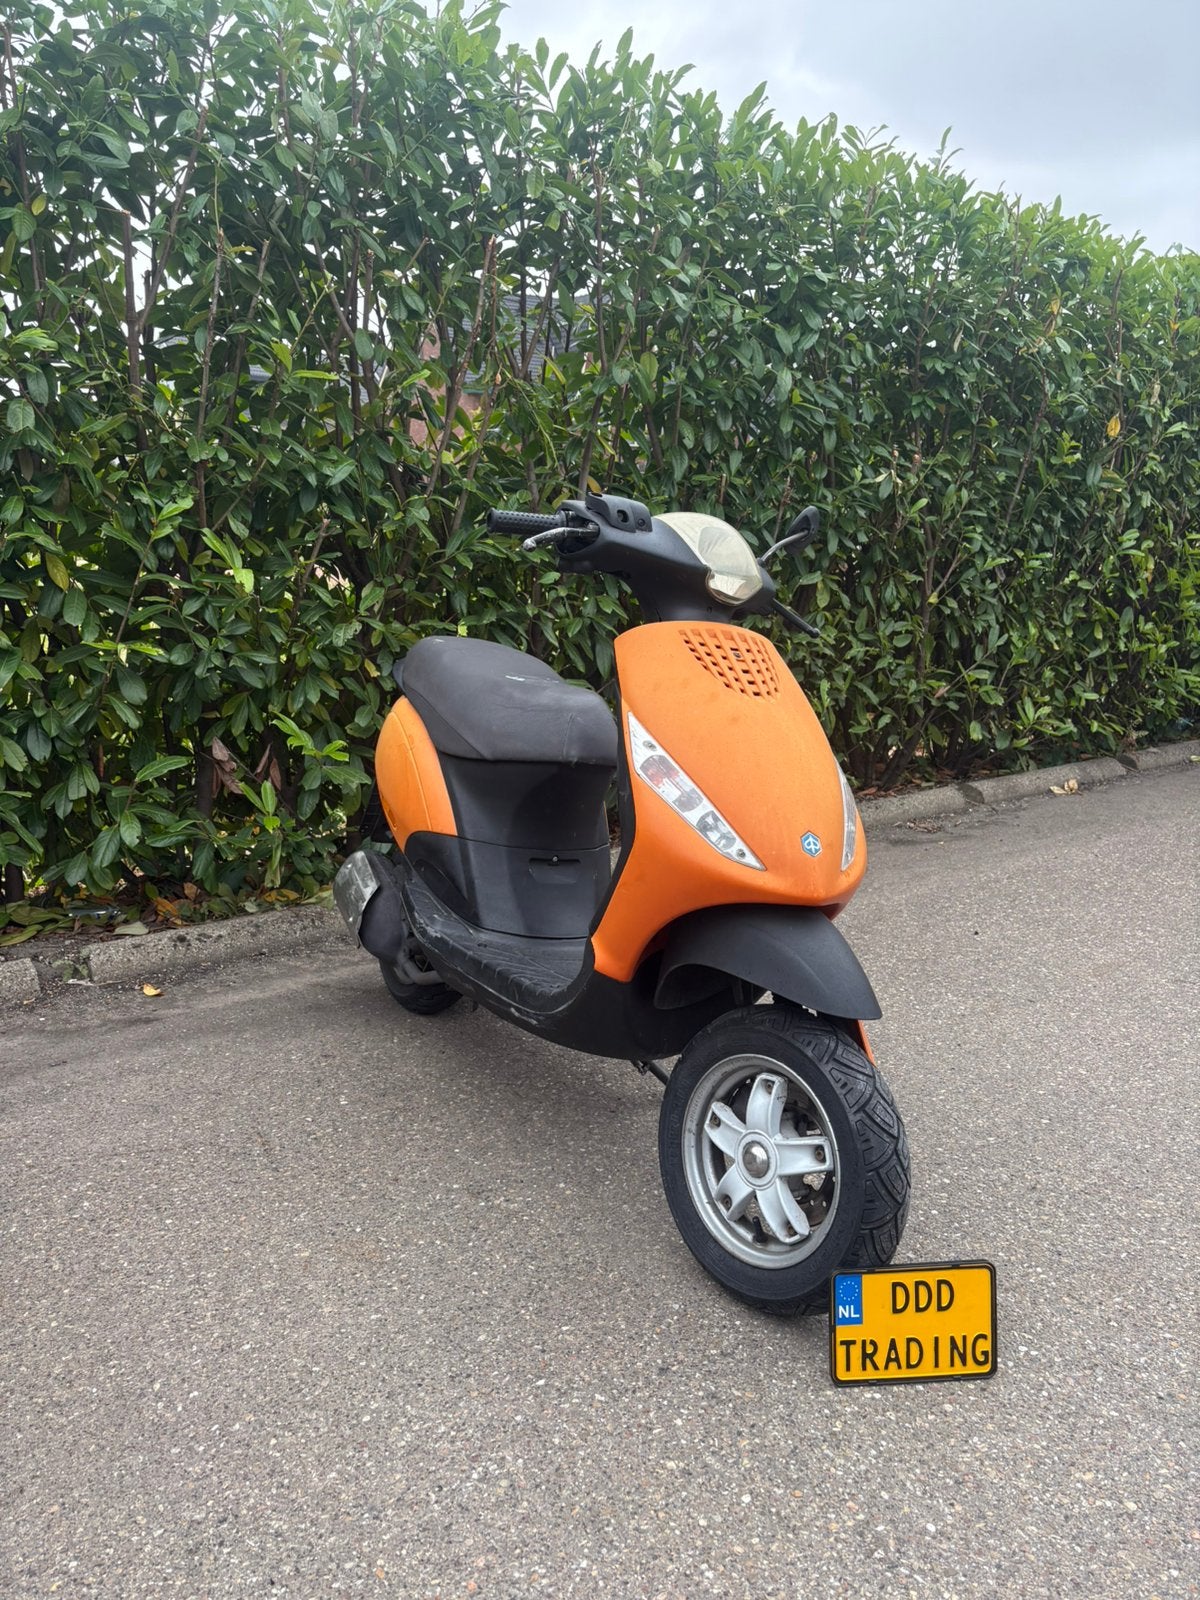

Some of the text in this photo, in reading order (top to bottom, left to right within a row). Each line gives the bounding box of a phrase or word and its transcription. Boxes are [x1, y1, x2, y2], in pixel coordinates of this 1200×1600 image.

[838, 1305, 860, 1319] NL
[891, 1279, 955, 1314] DDD
[839, 1333, 990, 1372] TRADING
